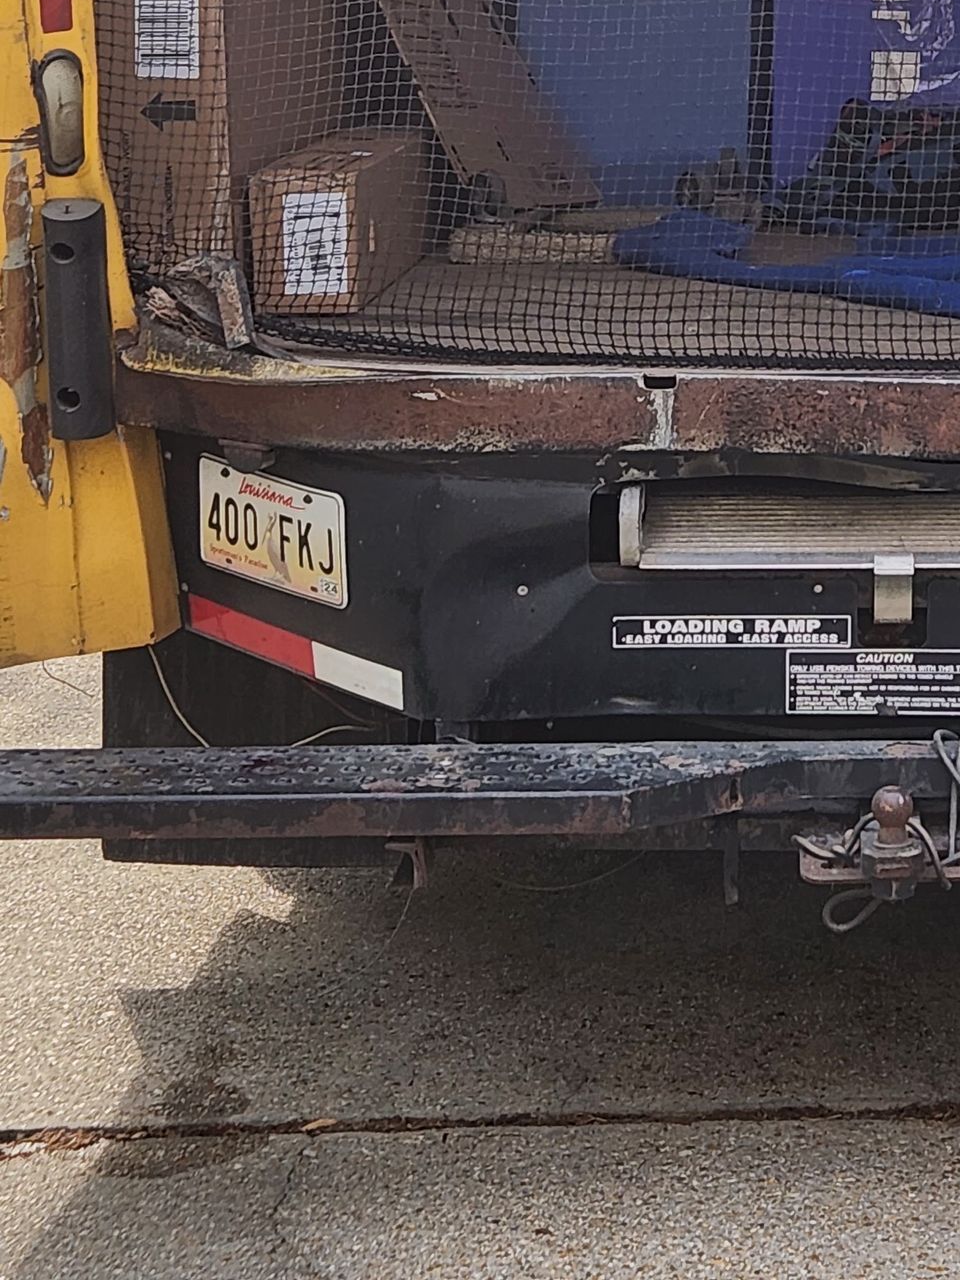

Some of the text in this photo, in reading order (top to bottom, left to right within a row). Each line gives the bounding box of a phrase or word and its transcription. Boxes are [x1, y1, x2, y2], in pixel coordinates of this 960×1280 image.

[238, 476, 306, 511] Louisiana
[208, 492, 334, 575] 400 FKJ
[643, 619, 822, 634] LOADING RAMP
[667, 634, 727, 644] LOADING
[784, 634, 838, 644] ACCESS
[856, 653, 914, 664] CAUTION
